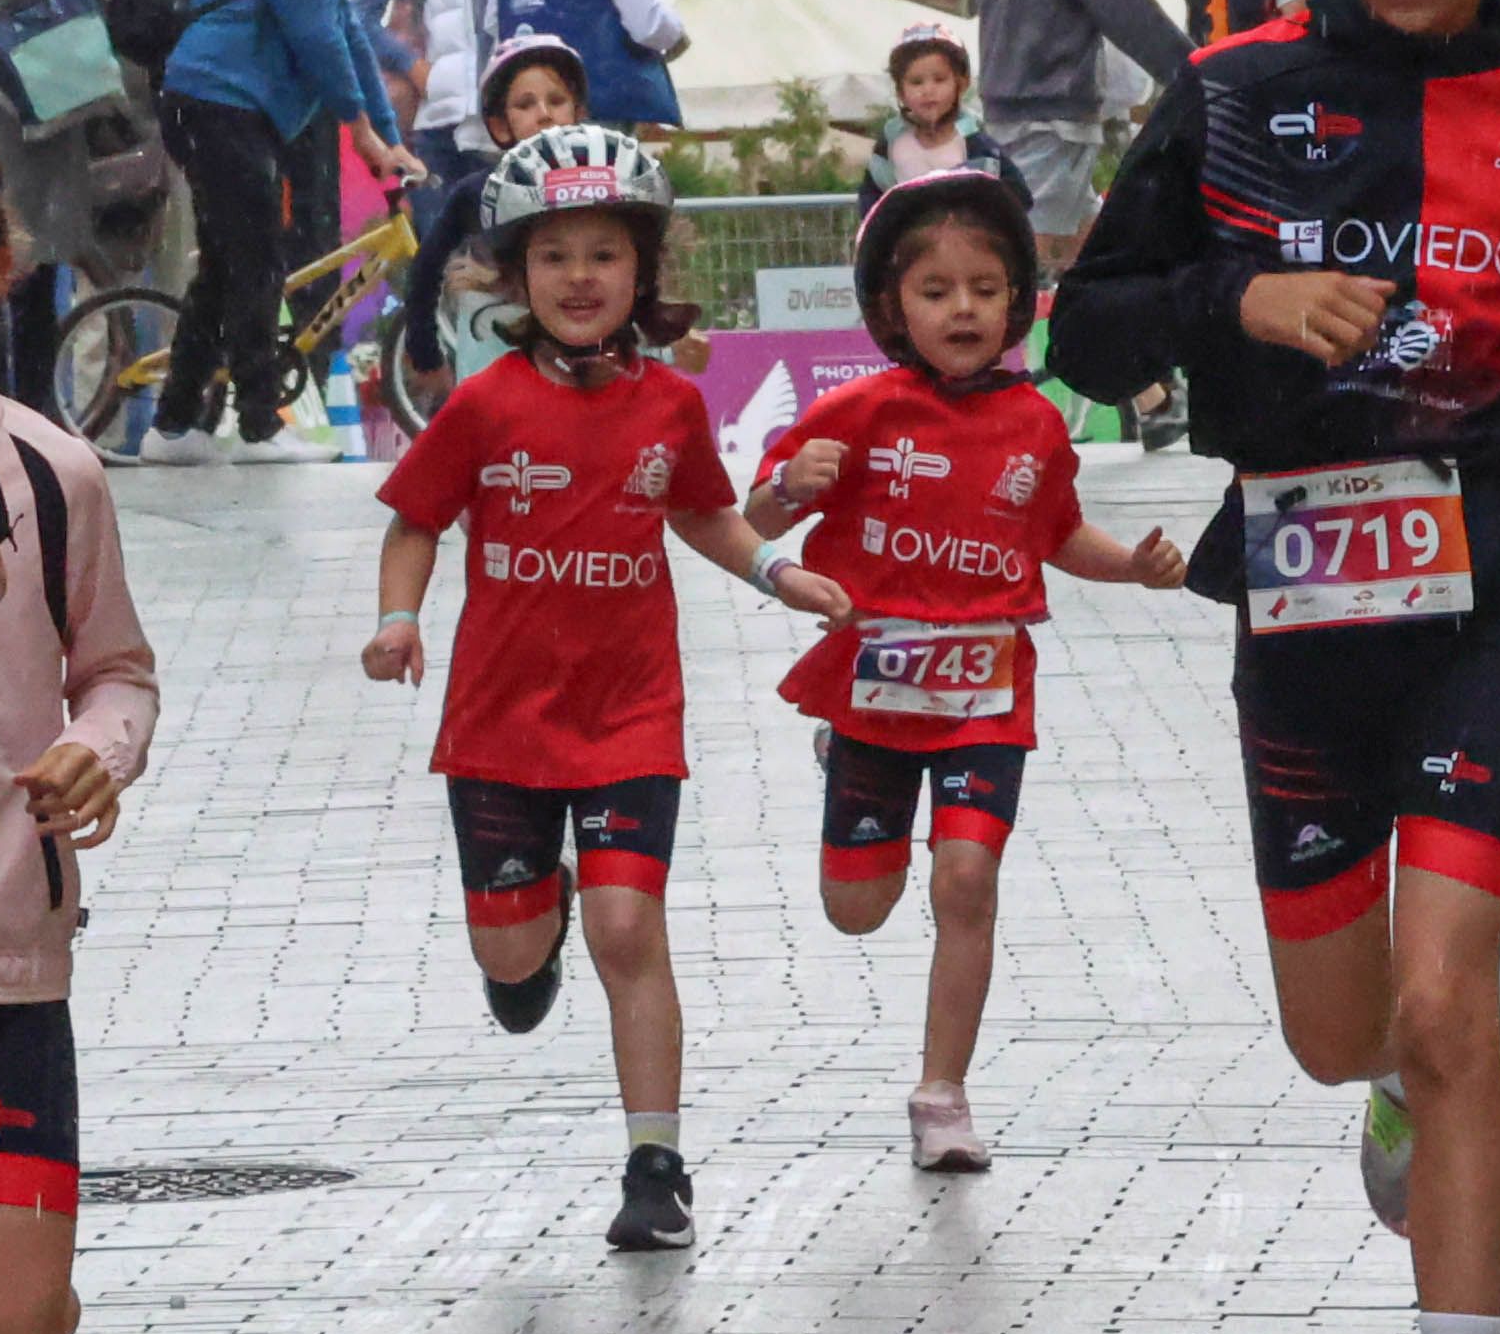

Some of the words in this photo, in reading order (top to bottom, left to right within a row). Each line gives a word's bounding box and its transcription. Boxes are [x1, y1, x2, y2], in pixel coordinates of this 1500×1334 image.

[555, 185, 609, 203] 0740
[891, 527, 1023, 582] OVIEDO
[1273, 508, 1441, 579] 0719
[514, 547, 657, 588] OVIEDO
[877, 642, 996, 685] 0743
